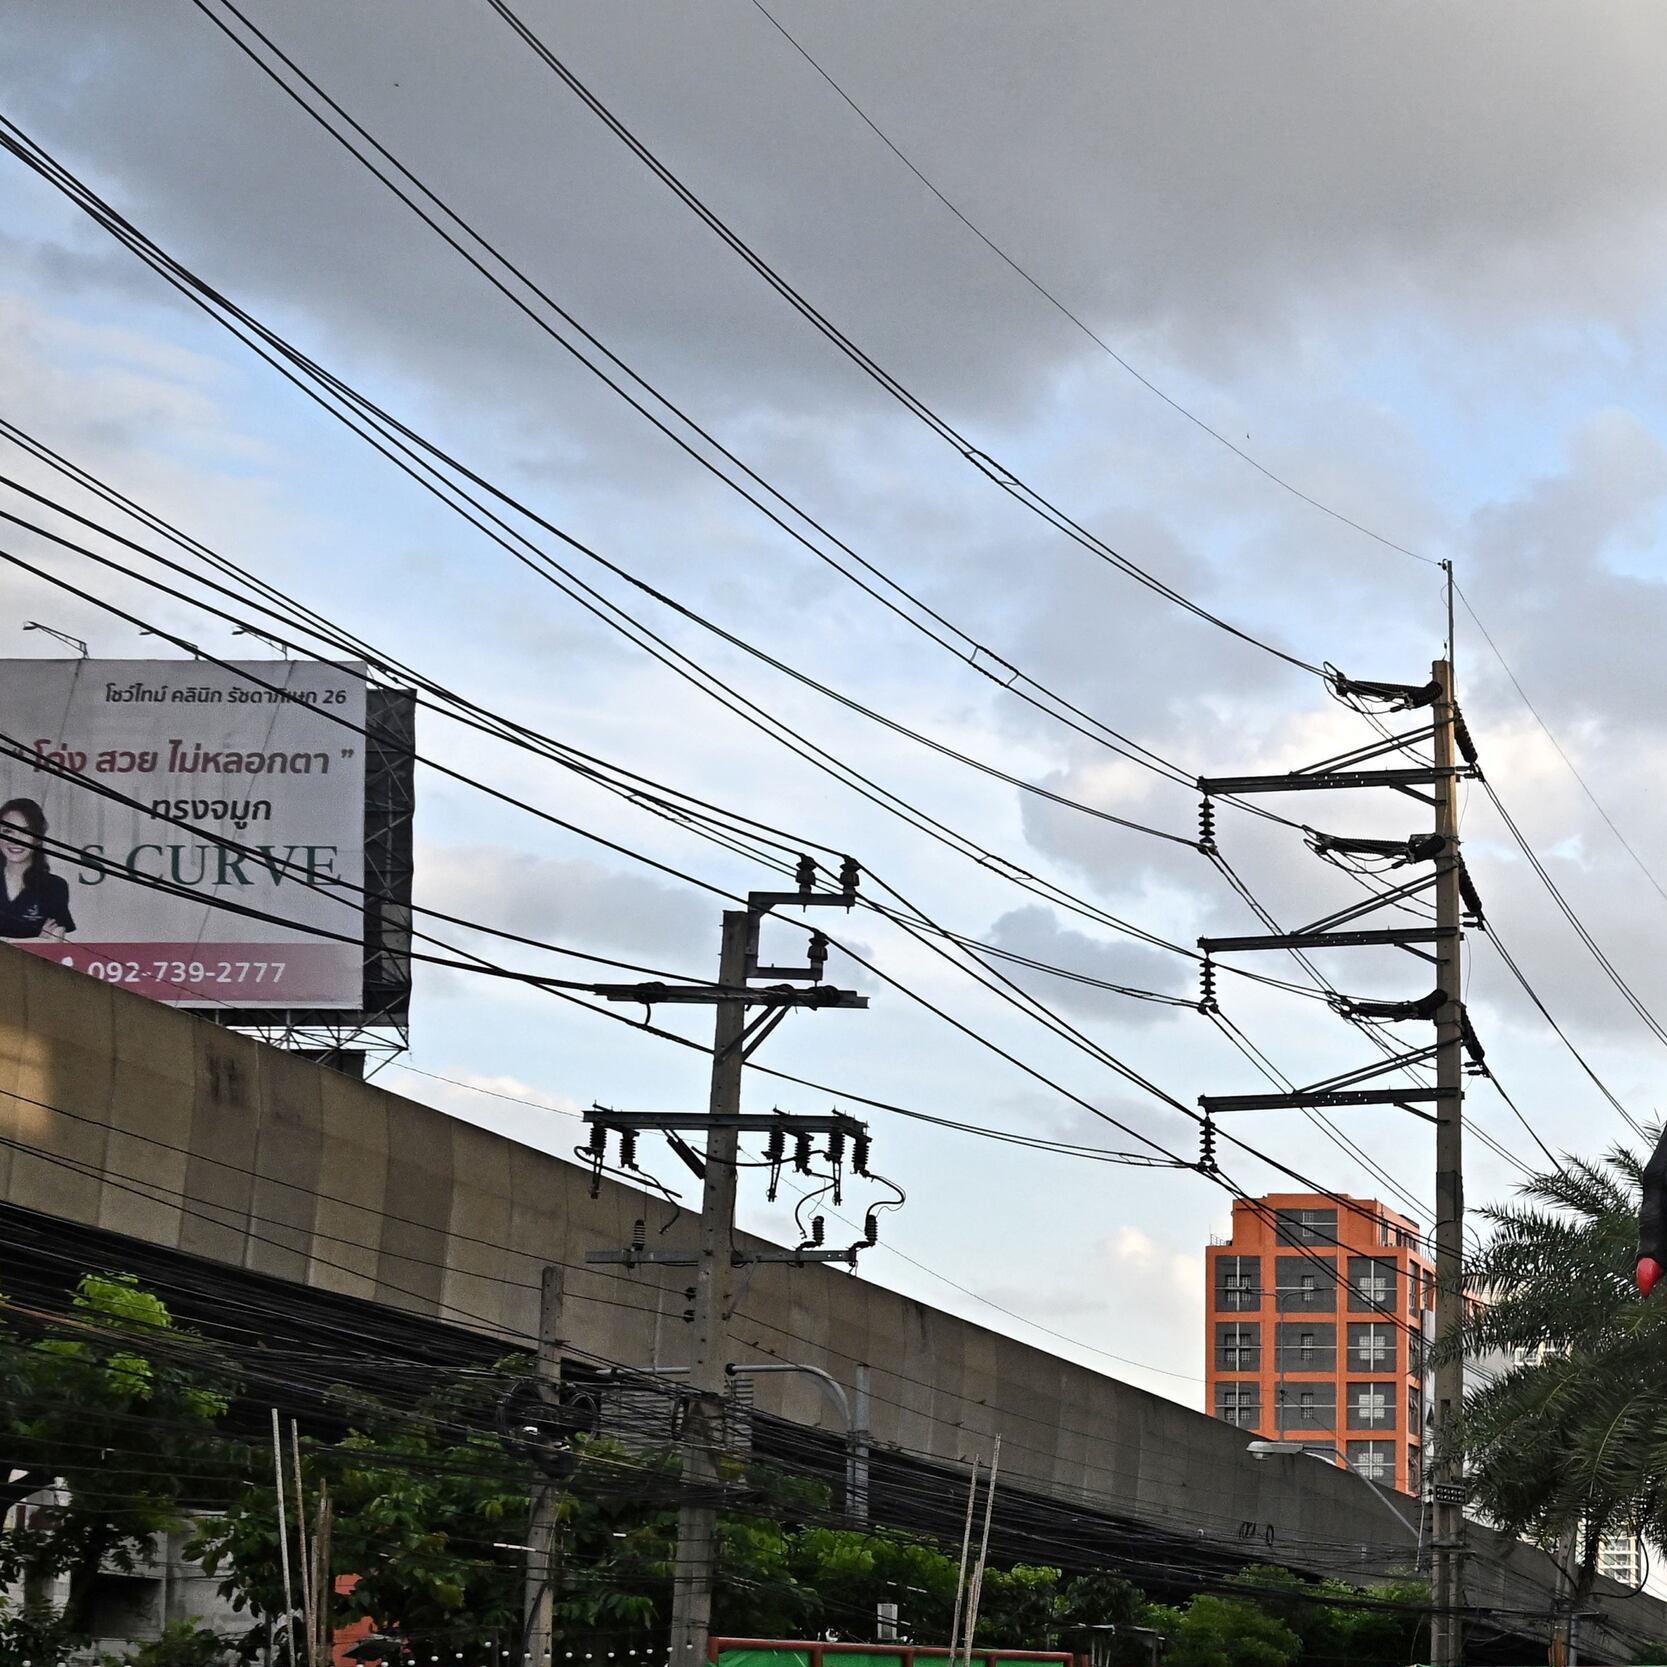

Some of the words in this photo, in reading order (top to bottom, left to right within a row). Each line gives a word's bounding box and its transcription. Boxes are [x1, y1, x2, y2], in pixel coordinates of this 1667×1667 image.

[170, 687, 223, 703] คลินิก
[322, 690, 347, 704] 26
[95, 749, 158, 774] สวย
[168, 739, 331, 775] ไม่หลอกตา
[150, 798, 272, 830] ทรงจมูก
[126, 845, 343, 887] CURVE
[87, 961, 287, 984] 092-739-2777
